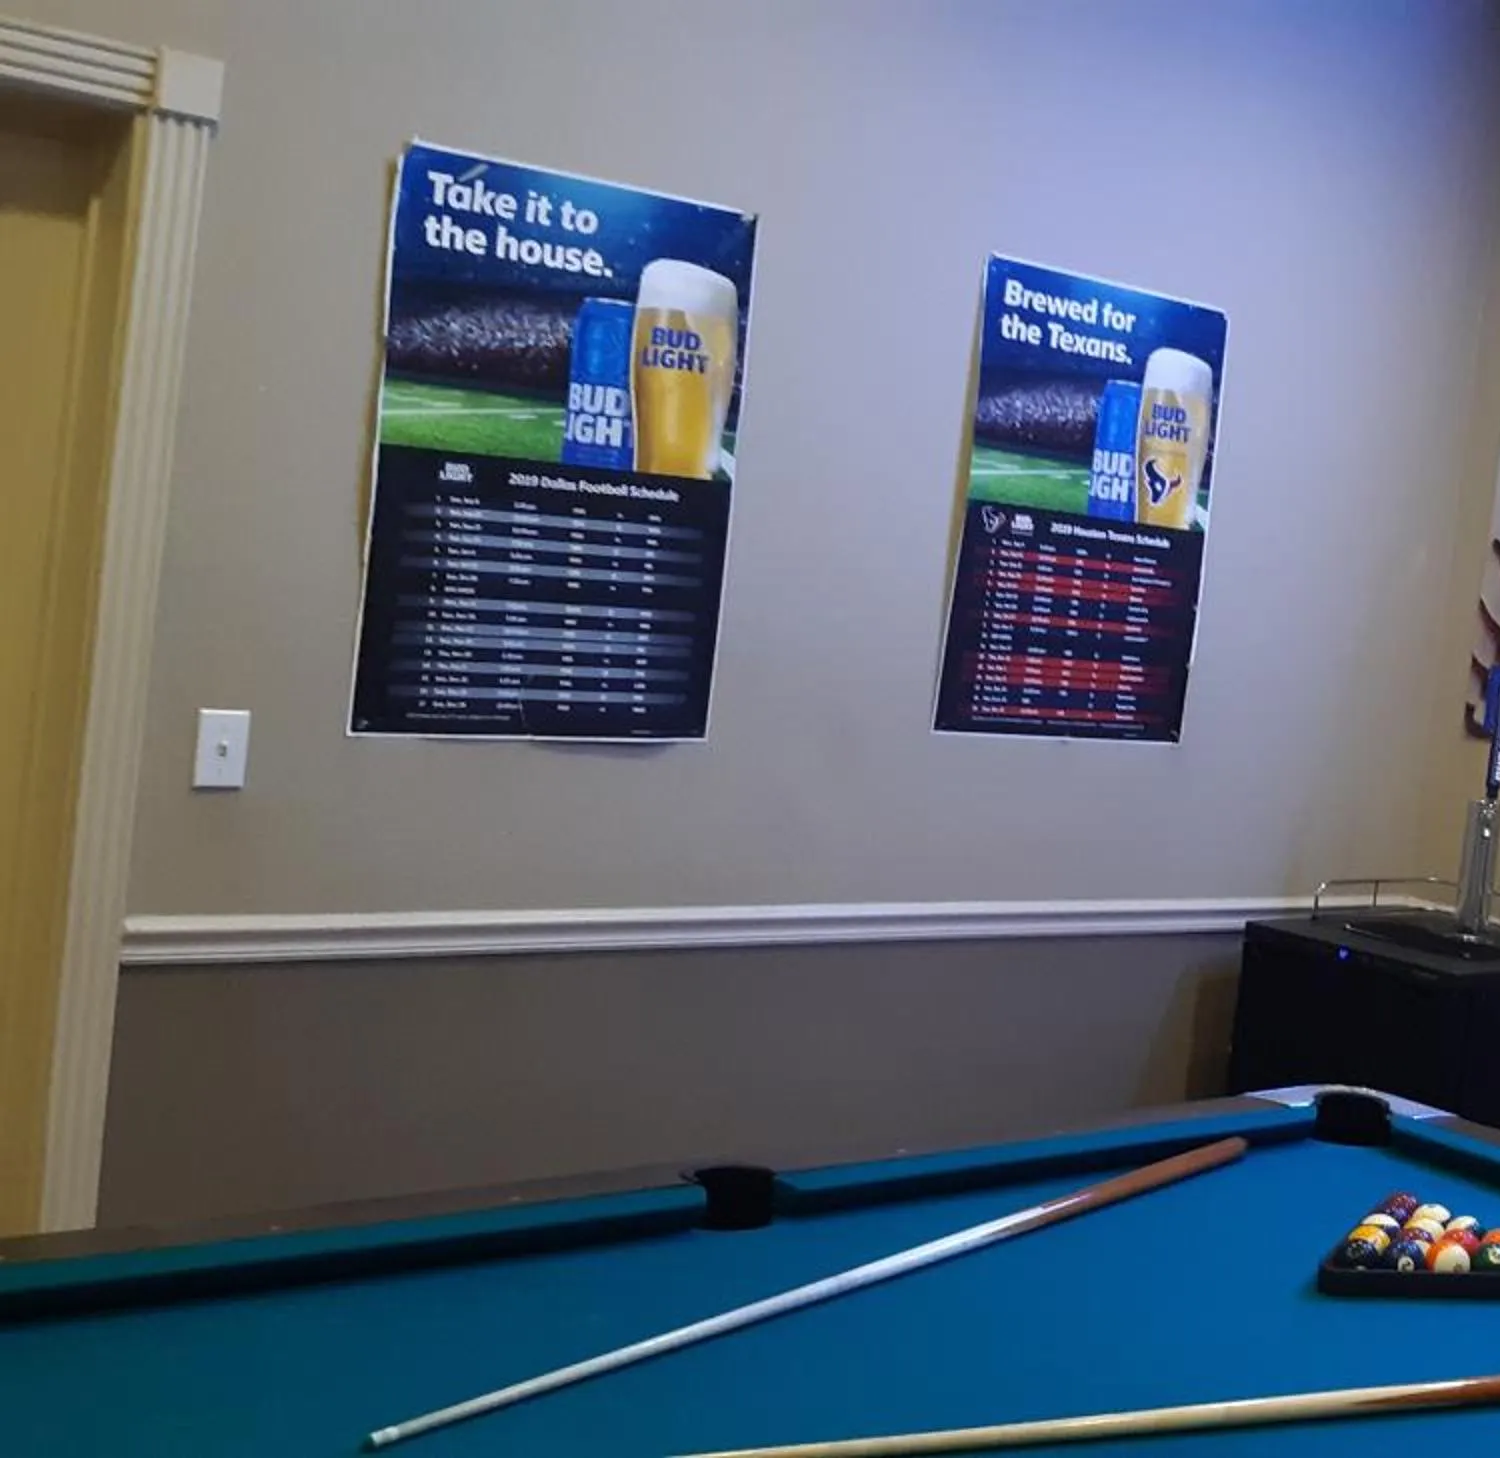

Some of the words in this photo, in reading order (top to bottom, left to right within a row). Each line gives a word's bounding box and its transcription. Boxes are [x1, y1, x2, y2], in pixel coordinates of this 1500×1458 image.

[427, 170, 517, 219] Take
[525, 189, 552, 226] it
[560, 200, 598, 234] to
[424, 214, 487, 255] the
[495, 225, 613, 278] house.
[1003, 279, 1098, 325] Brewed
[1102, 302, 1136, 333] for
[651, 327, 702, 351] BUD
[1001, 313, 1042, 345] the
[1047, 323, 1133, 365] Texans.
[641, 346, 710, 374] LIGHT
[568, 383, 630, 417] BUD
[1152, 403, 1187, 424] BUD
[564, 413, 633, 448] IGH
[1144, 420, 1191, 442] LIGHT
